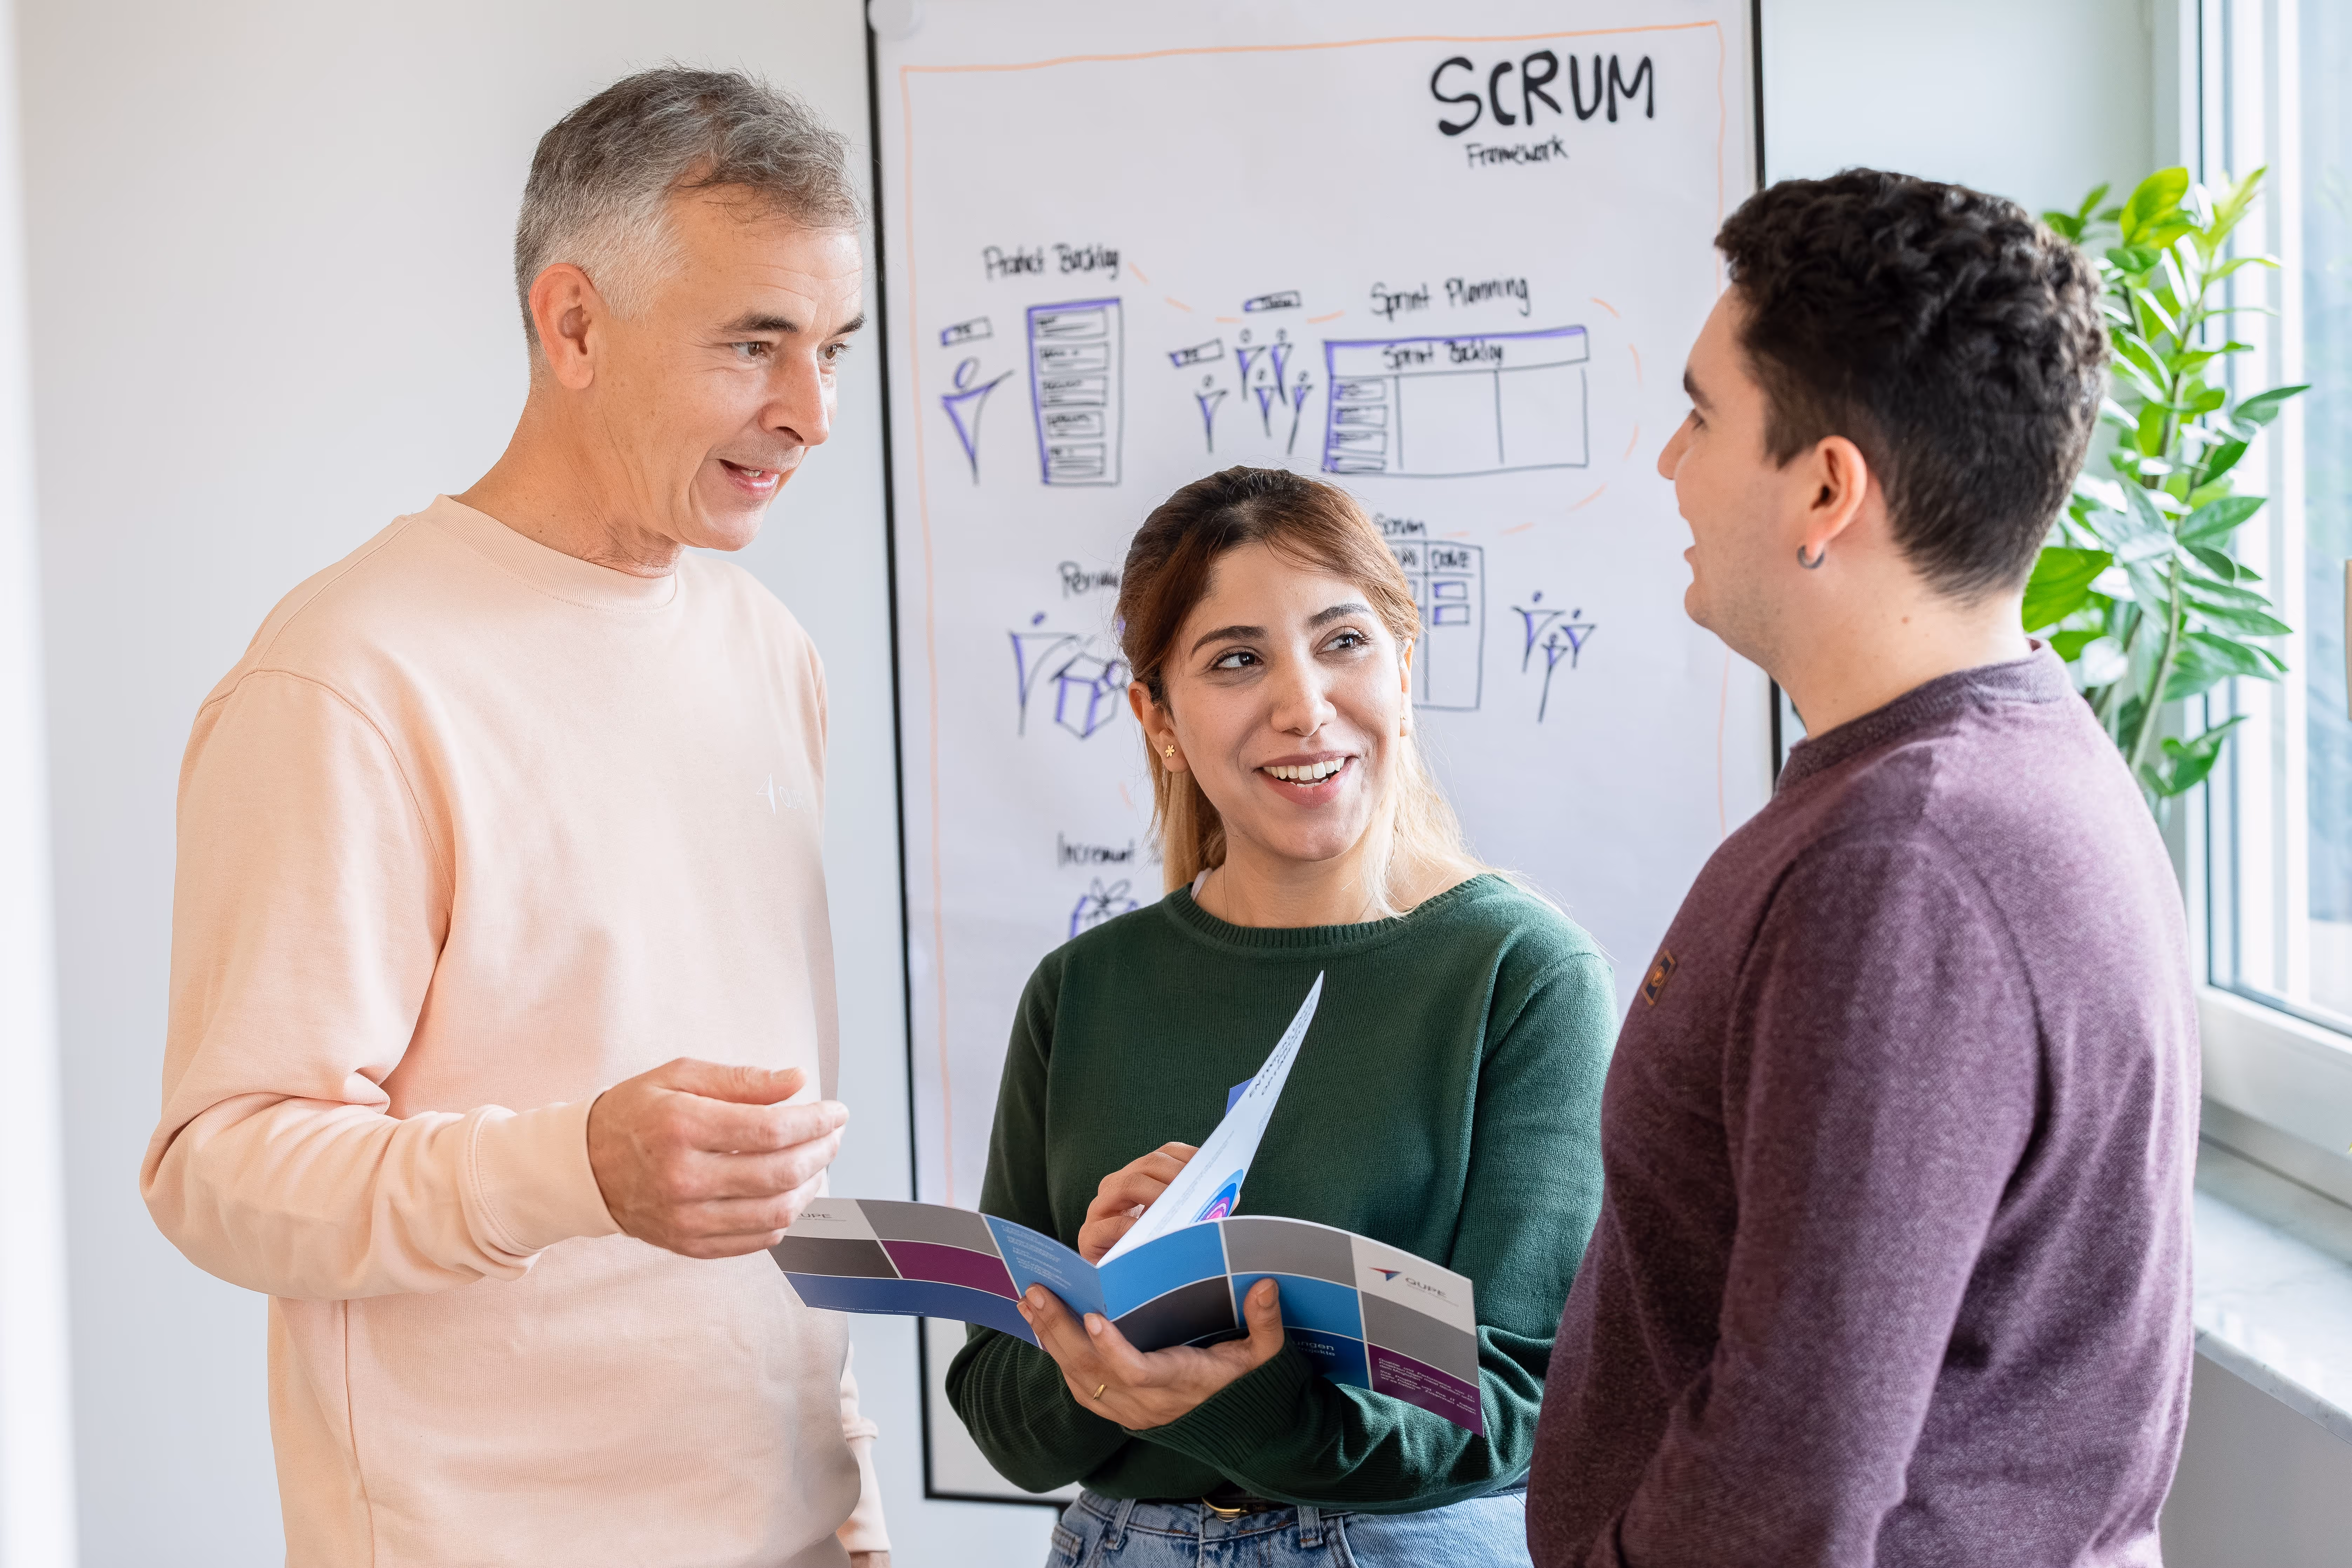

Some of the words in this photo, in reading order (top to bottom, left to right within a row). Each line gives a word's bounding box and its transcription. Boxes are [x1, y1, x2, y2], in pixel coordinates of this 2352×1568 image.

[1430, 50, 1654, 135] SCRUM
[1465, 135, 1569, 169] Framework
[1370, 282, 1431, 323] Sprint
[1445, 278, 1530, 317] Planning
[1381, 342, 1433, 379] Sprint
